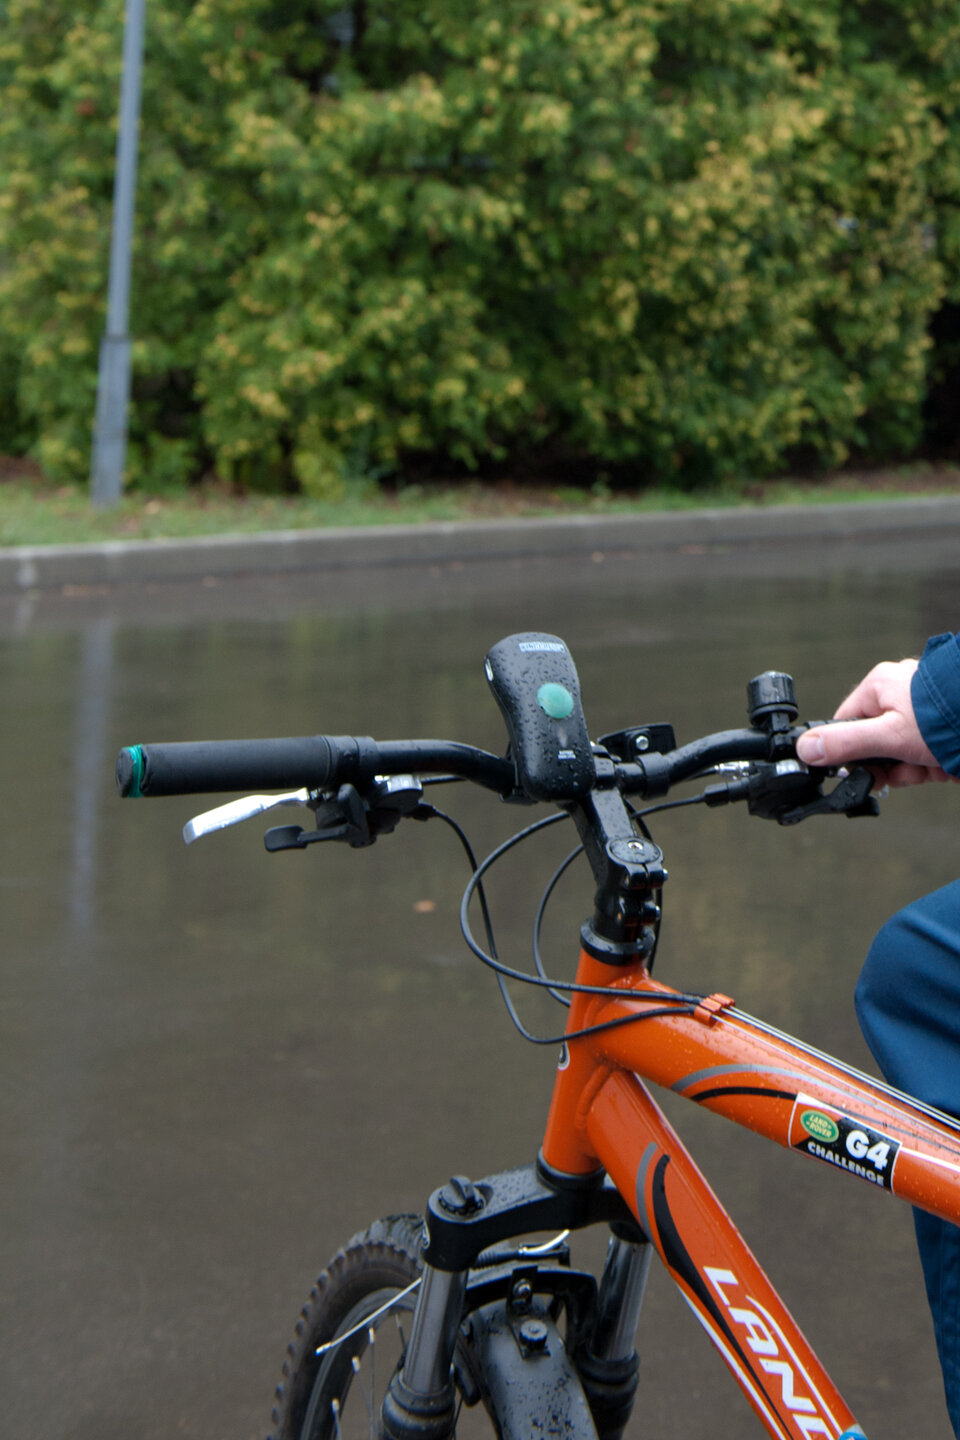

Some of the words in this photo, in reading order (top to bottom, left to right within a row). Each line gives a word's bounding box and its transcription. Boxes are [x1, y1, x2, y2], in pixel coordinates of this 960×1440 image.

[809, 1115, 829, 1128] LAND
[809, 1124, 832, 1139] ROVER
[807, 1140, 885, 1187] CHALLENGE
[845, 1129, 891, 1172] G4
